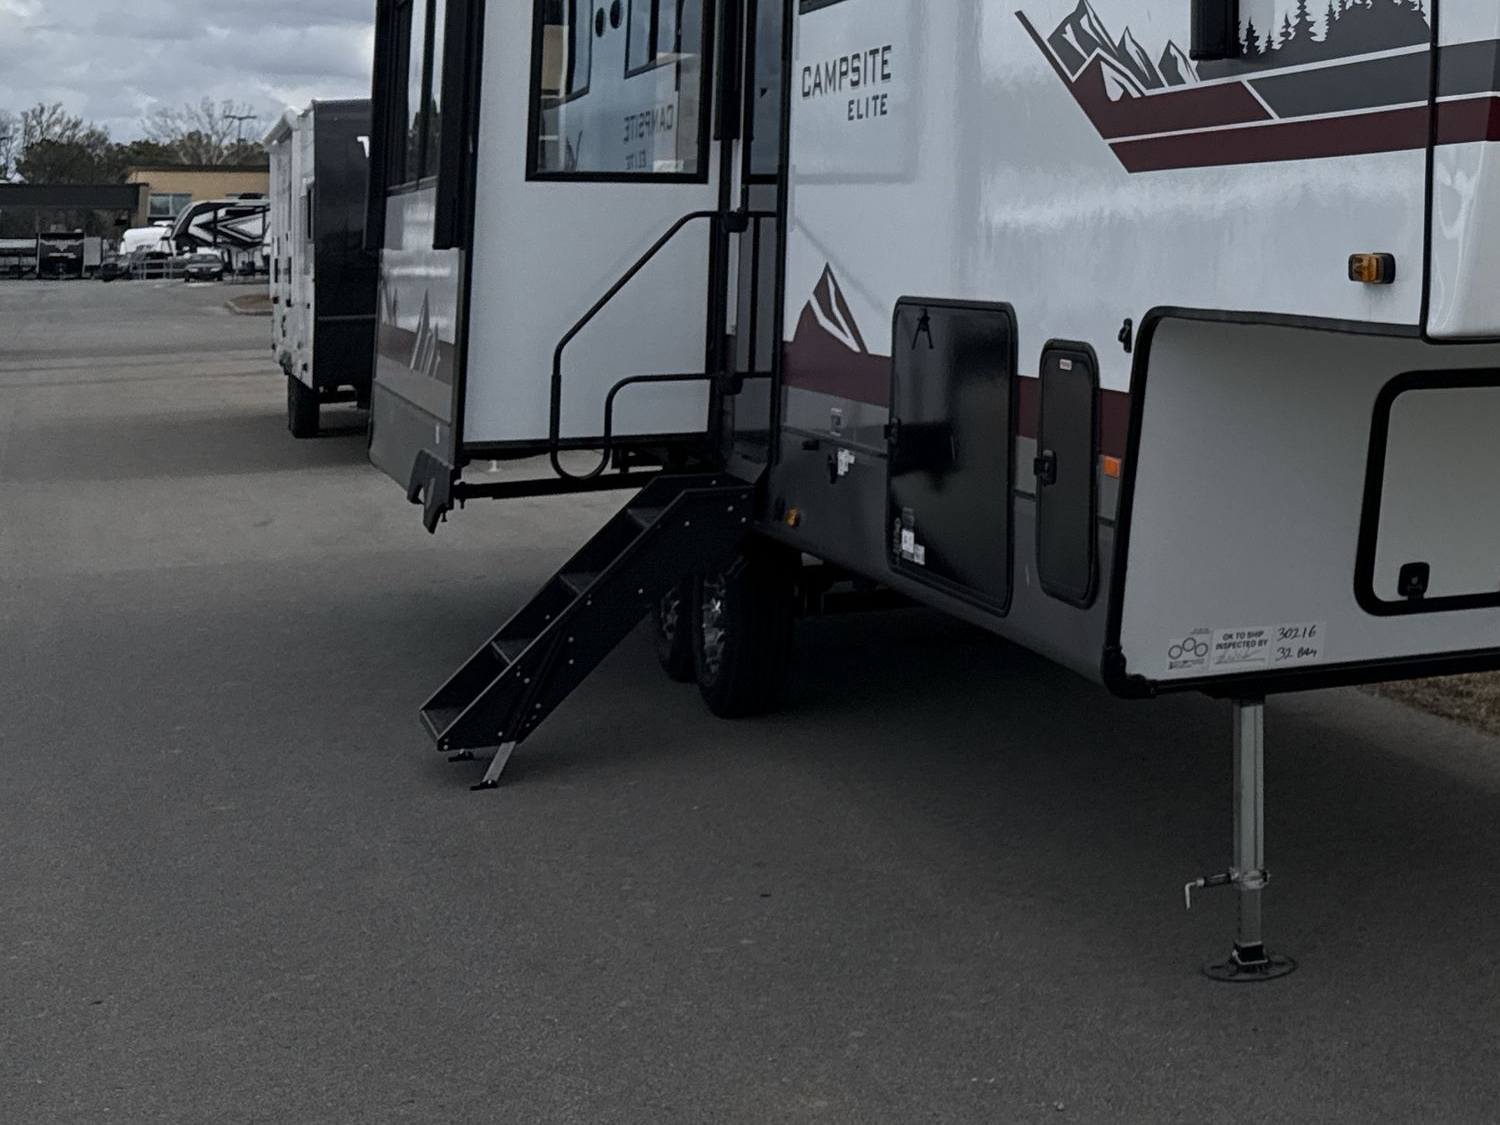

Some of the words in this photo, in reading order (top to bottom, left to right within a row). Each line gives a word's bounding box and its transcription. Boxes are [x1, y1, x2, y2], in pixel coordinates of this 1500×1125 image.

[801, 44, 892, 99] CAMPSITE
[847, 93, 888, 121] ELITE
[1222, 633, 1234, 641] OK
[1236, 632, 1246, 640] TO
[1247, 630, 1264, 639] SHIP
[1276, 624, 1317, 642] 30216
[1215, 639, 1257, 650] INSPECTED
[1257, 639, 1268, 647] BY
